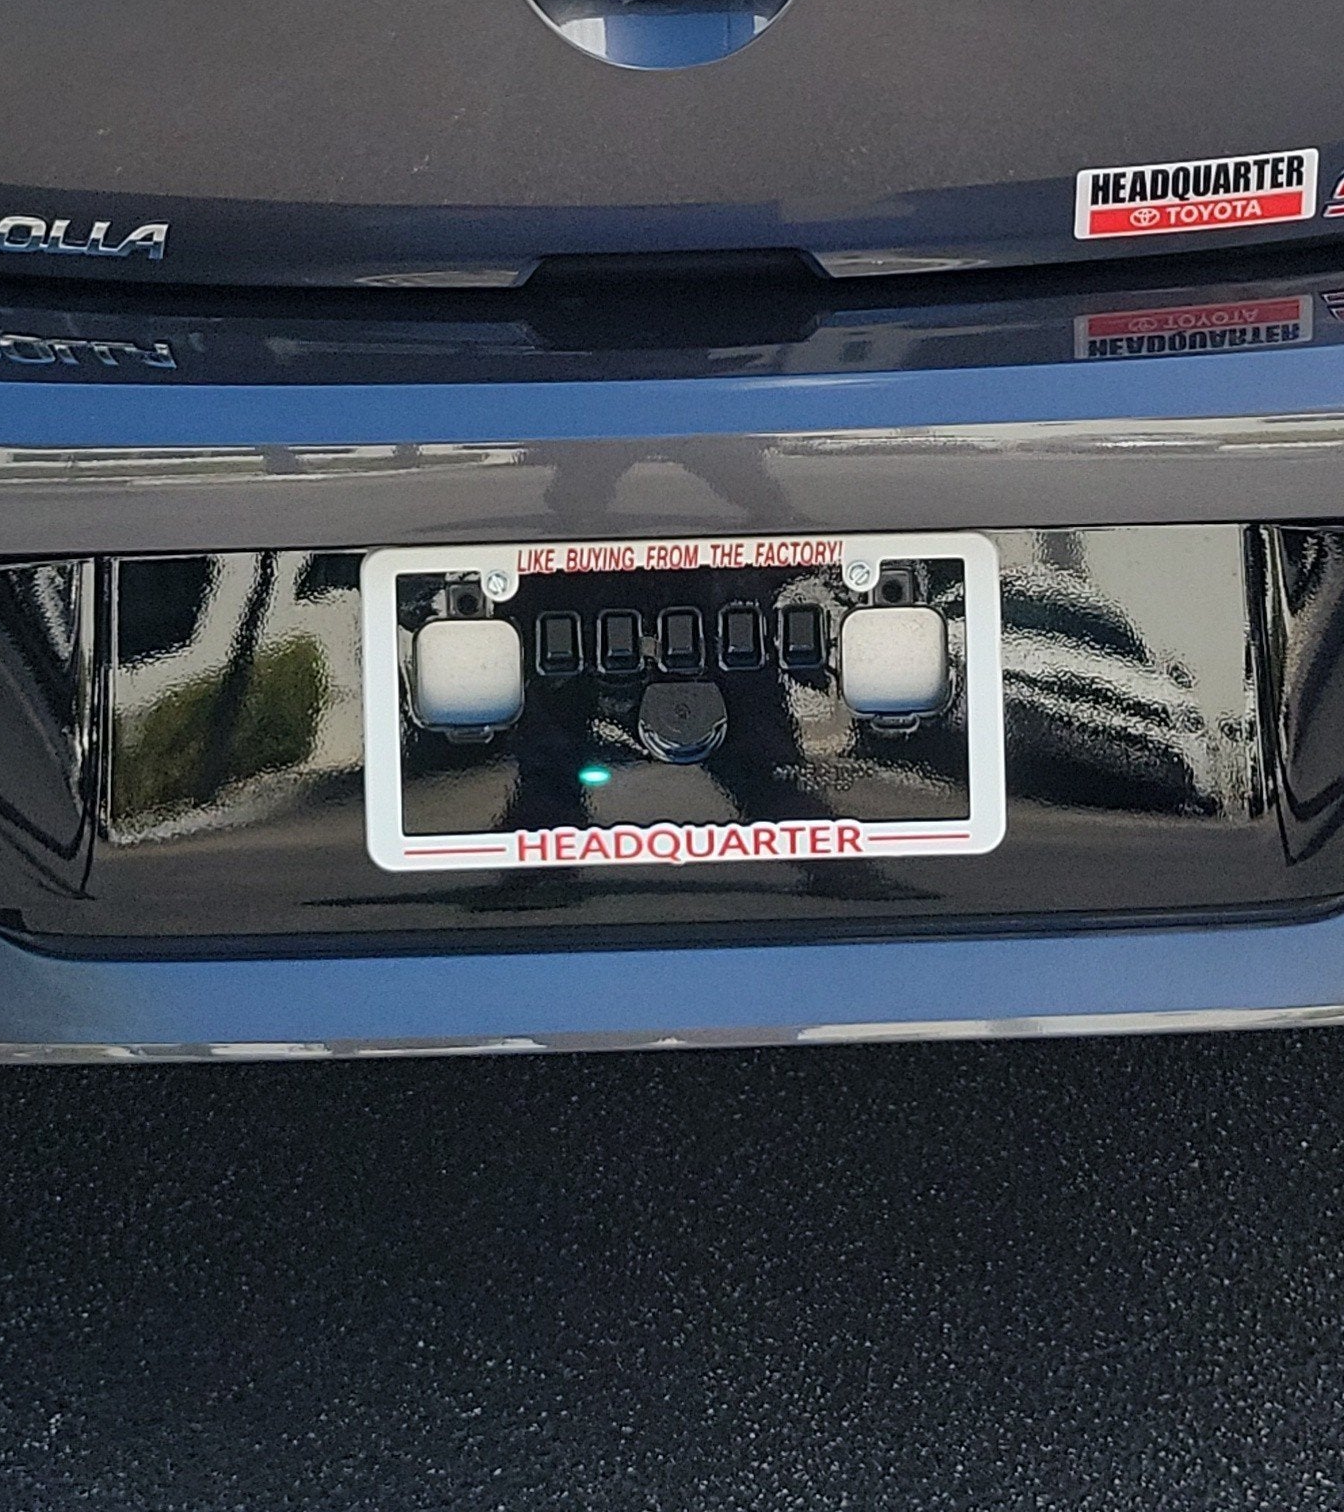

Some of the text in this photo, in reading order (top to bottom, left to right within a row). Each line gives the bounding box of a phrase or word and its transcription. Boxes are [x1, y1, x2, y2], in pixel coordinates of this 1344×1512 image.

[1090, 154, 1305, 206] HEADQUARTER
[1166, 199, 1263, 225] TOYOTA
[517, 540, 844, 573] LIKE BUYING FROM THE FACTORY!
[517, 825, 864, 862] HEADQUARTER
